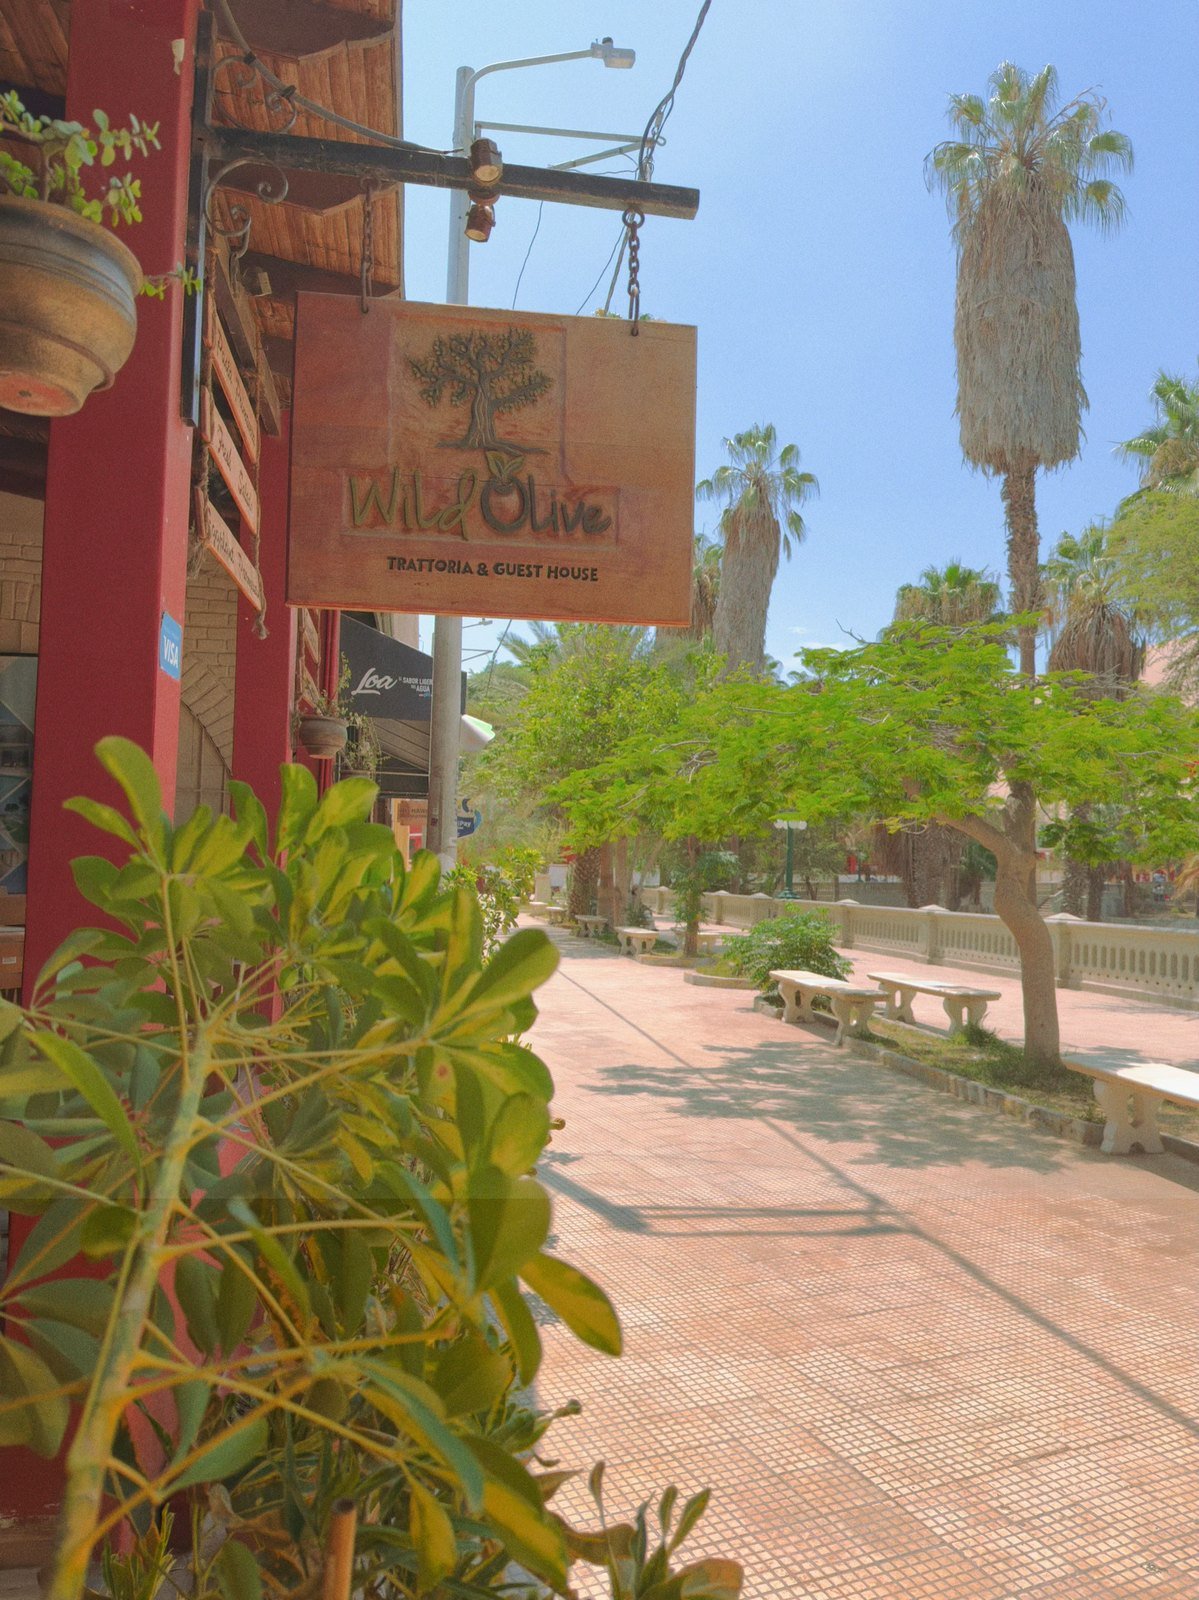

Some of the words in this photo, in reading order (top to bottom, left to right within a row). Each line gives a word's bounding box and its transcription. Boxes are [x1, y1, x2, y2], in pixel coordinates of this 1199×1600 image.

[348, 464, 478, 541] Wild
[481, 474, 611, 534] Olive
[387, 556, 474, 574] TRATTORIA
[476, 562, 489, 576] &
[493, 562, 543, 578] GUEST
[547, 565, 598, 581] HOUSE
[163, 634, 179, 669] VISA
[351, 667, 397, 696] Loa
